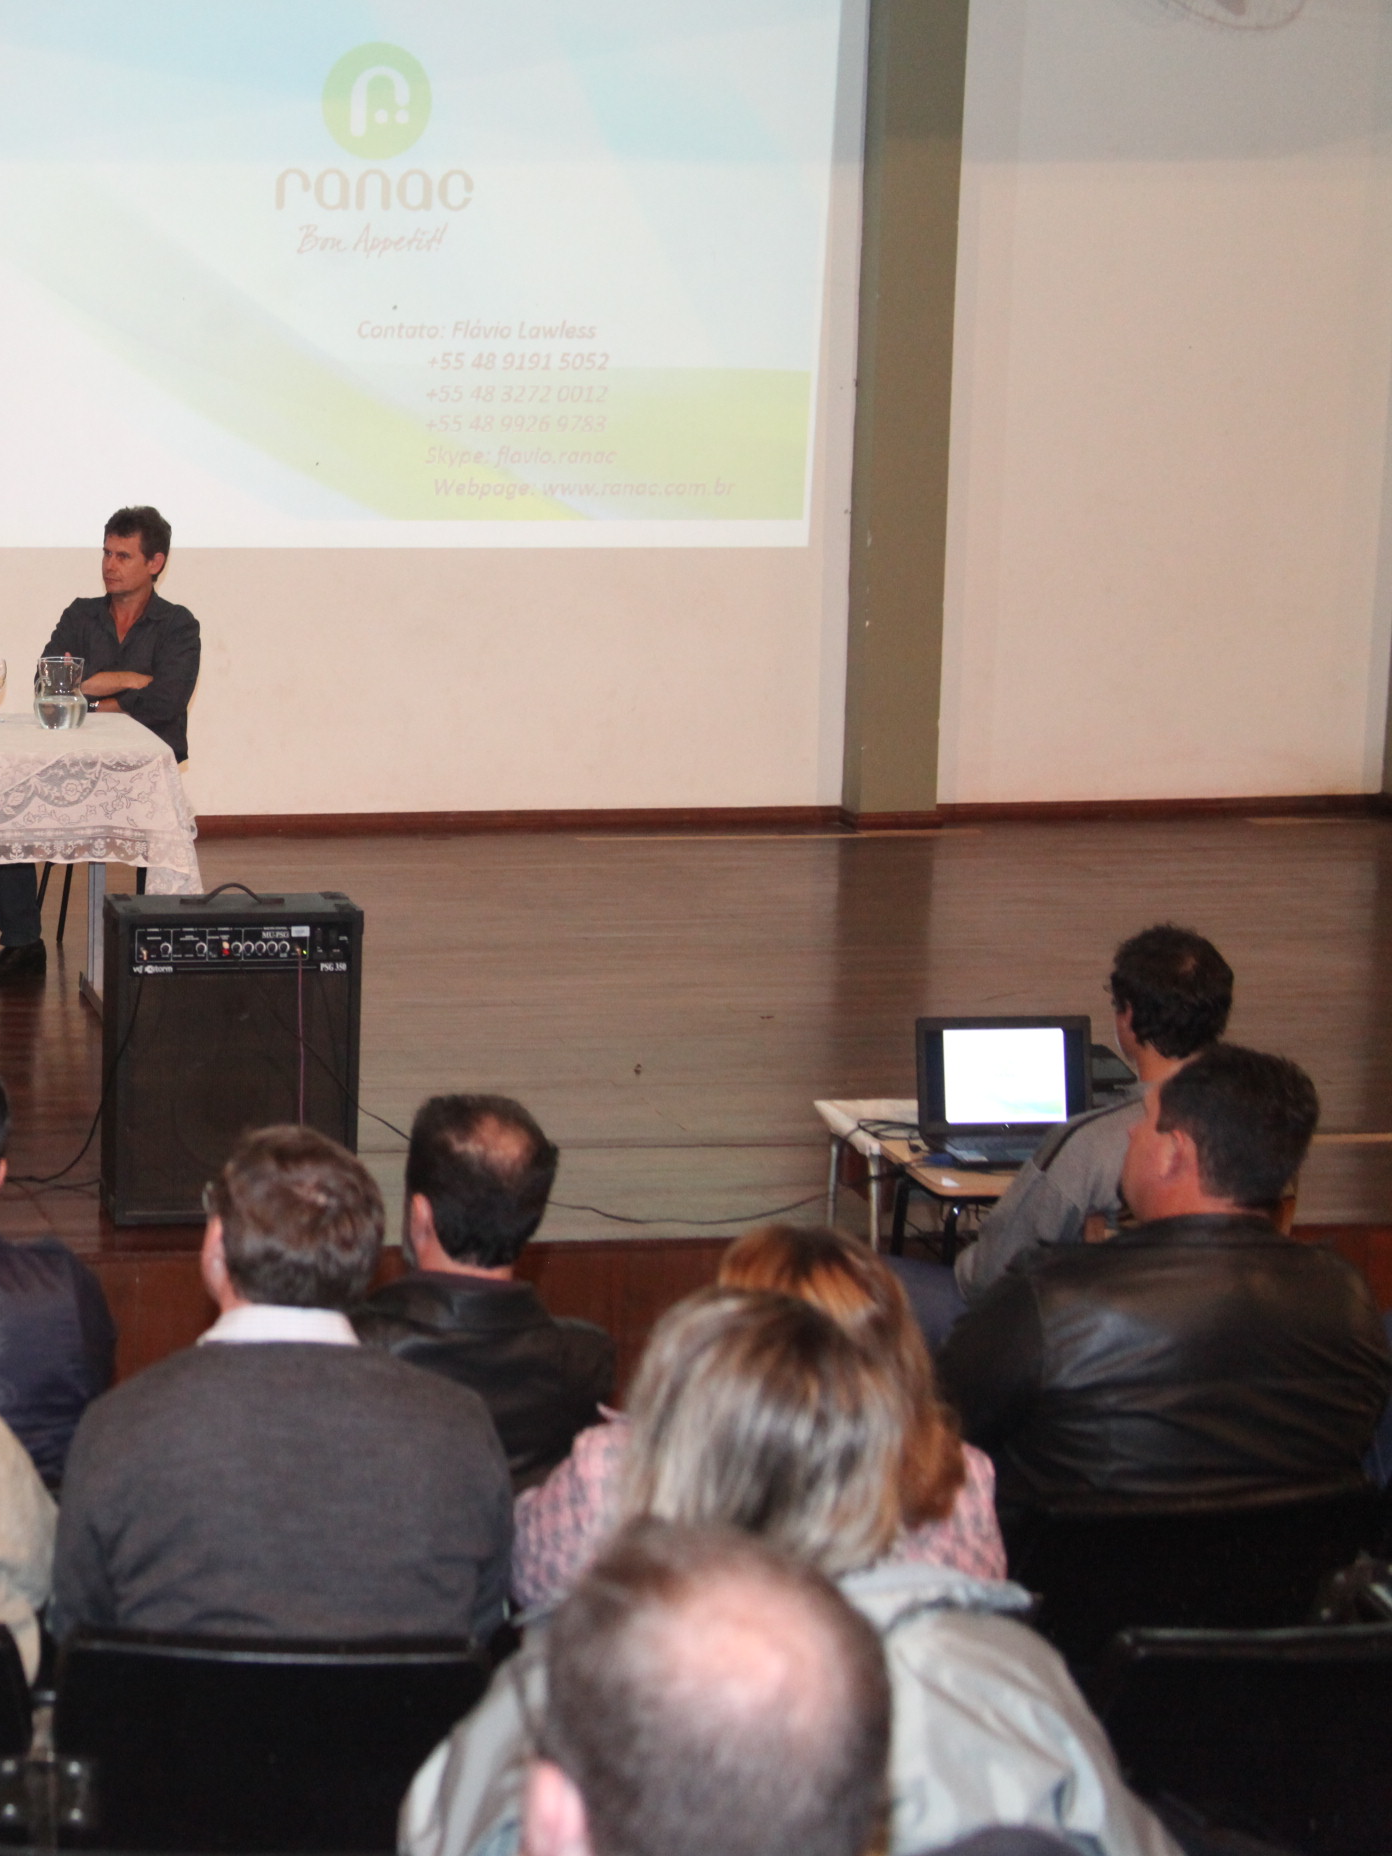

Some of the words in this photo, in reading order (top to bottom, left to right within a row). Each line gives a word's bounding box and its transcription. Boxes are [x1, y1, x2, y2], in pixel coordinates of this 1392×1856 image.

[275, 167, 475, 212] ranac
[297, 223, 346, 255] Bon
[356, 319, 446, 340] Contato:
[452, 318, 512, 340] Flávio
[517, 319, 597, 340] Lawless
[427, 352, 465, 371] +55
[471, 352, 496, 371] 48
[502, 352, 552, 371] 9191
[558, 352, 610, 371] 5052
[425, 384, 464, 403] +55
[470, 384, 495, 403] 48
[500, 384, 552, 403] 3272
[557, 384, 609, 403] 0012
[425, 415, 463, 433] +55
[468, 415, 495, 433] 48
[499, 415, 551, 433] 9926
[556, 415, 608, 433] 9783
[424, 446, 490, 468] Skype:
[493, 446, 618, 468] flavio.ranac
[433, 477, 535, 500] Webpage:
[542, 476, 736, 498] www.ranac.com.br
[319, 962, 334, 972] PSG
